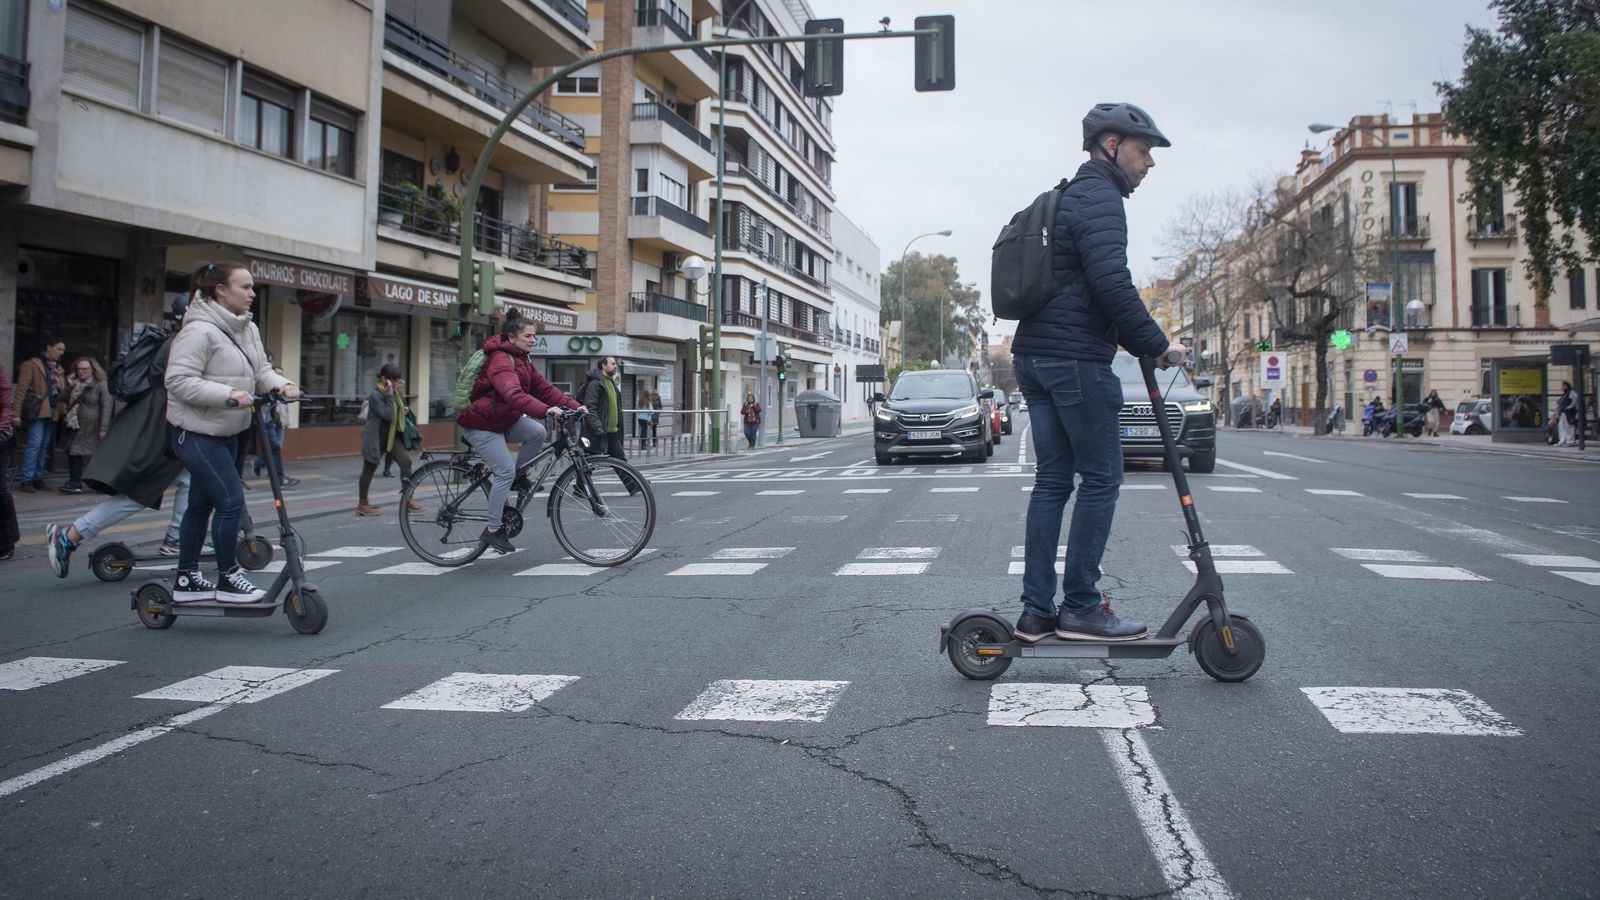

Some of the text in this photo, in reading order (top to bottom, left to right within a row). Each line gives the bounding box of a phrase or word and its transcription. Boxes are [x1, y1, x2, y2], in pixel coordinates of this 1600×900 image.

[250, 260, 349, 292] CHURROS CHOCOLATE
[385, 283, 414, 301] LAGO
[417, 289, 431, 304] DE
[523, 307, 542, 322] TAPAS
[543, 311, 559, 325] desde
[560, 314, 573, 327] 1969
[1129, 427, 1149, 436] 5290
